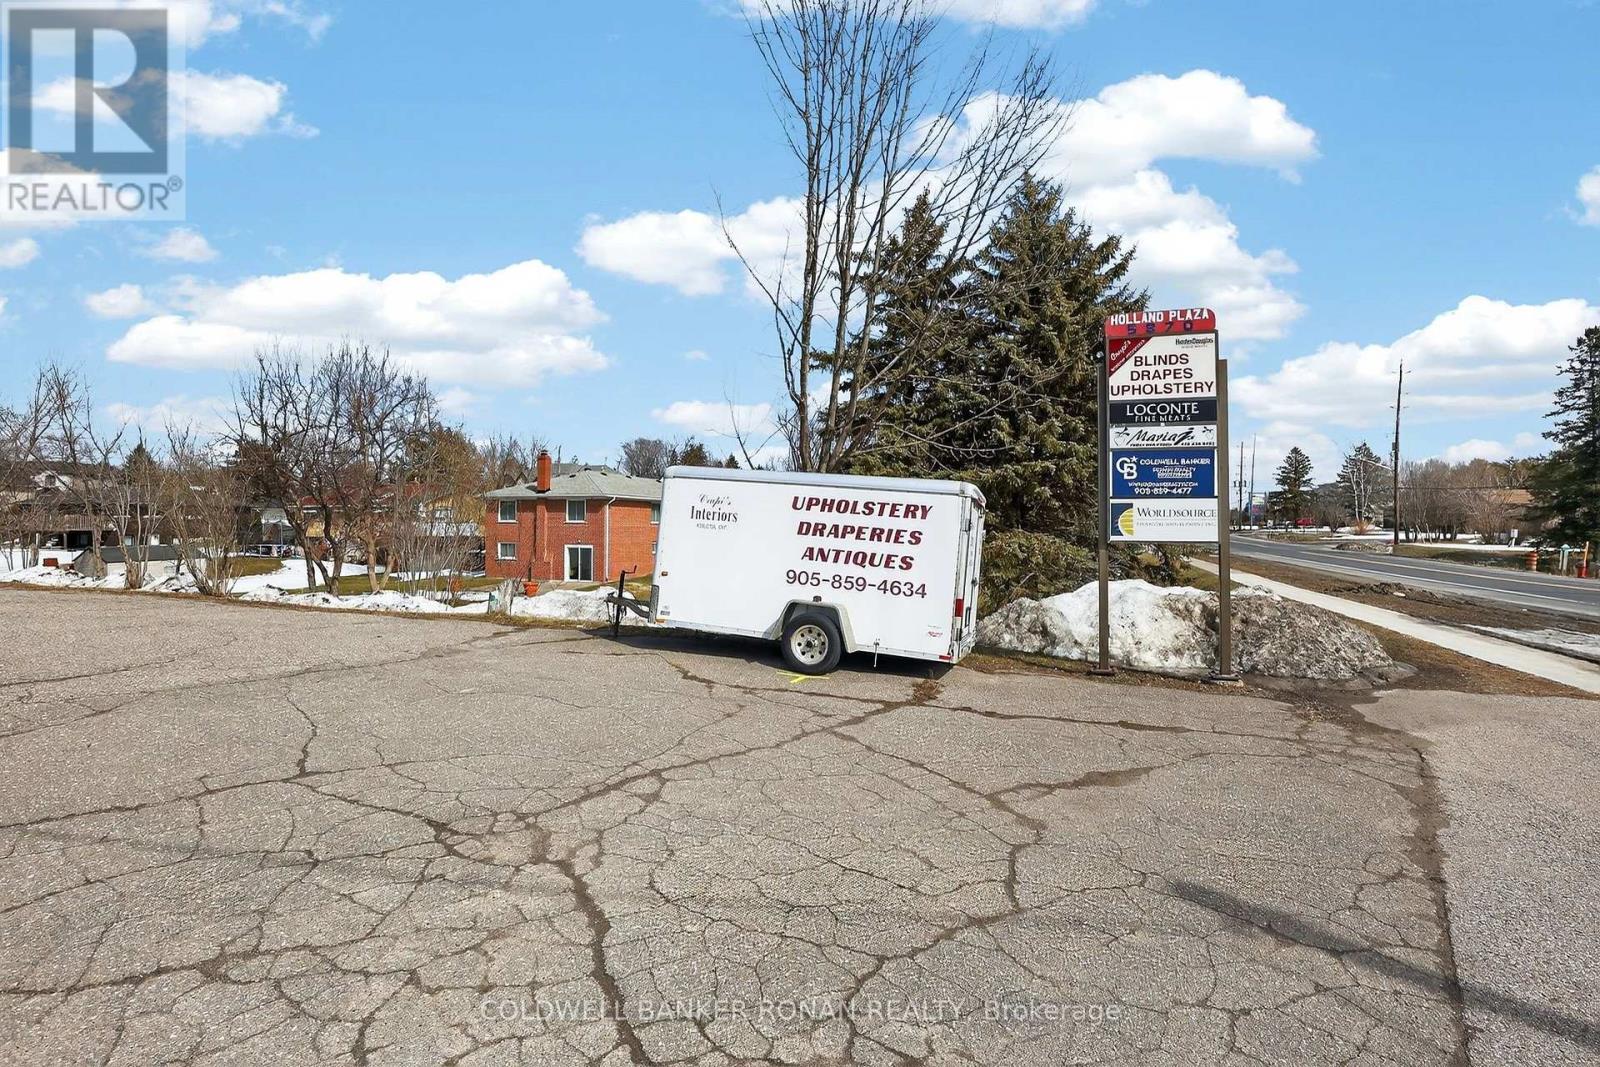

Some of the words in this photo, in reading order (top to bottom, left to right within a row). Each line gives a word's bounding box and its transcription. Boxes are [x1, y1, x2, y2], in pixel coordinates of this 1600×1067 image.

[1110, 311, 1164, 326] HOLLAND
[1169, 308, 1210, 323] PLAZA
[1133, 353, 1190, 367] BLINDS
[1130, 368, 1194, 382] DRAPES
[1110, 381, 1215, 397] UPHOLSTERY
[1126, 402, 1200, 416] LOCONTE
[689, 505, 739, 523] Interiors
[791, 495, 934, 521] UPHOLSTERY
[796, 521, 924, 546] DRAPERIES
[800, 546, 916, 571] ANTIQUES
[785, 569, 928, 599] 905-859-4634
